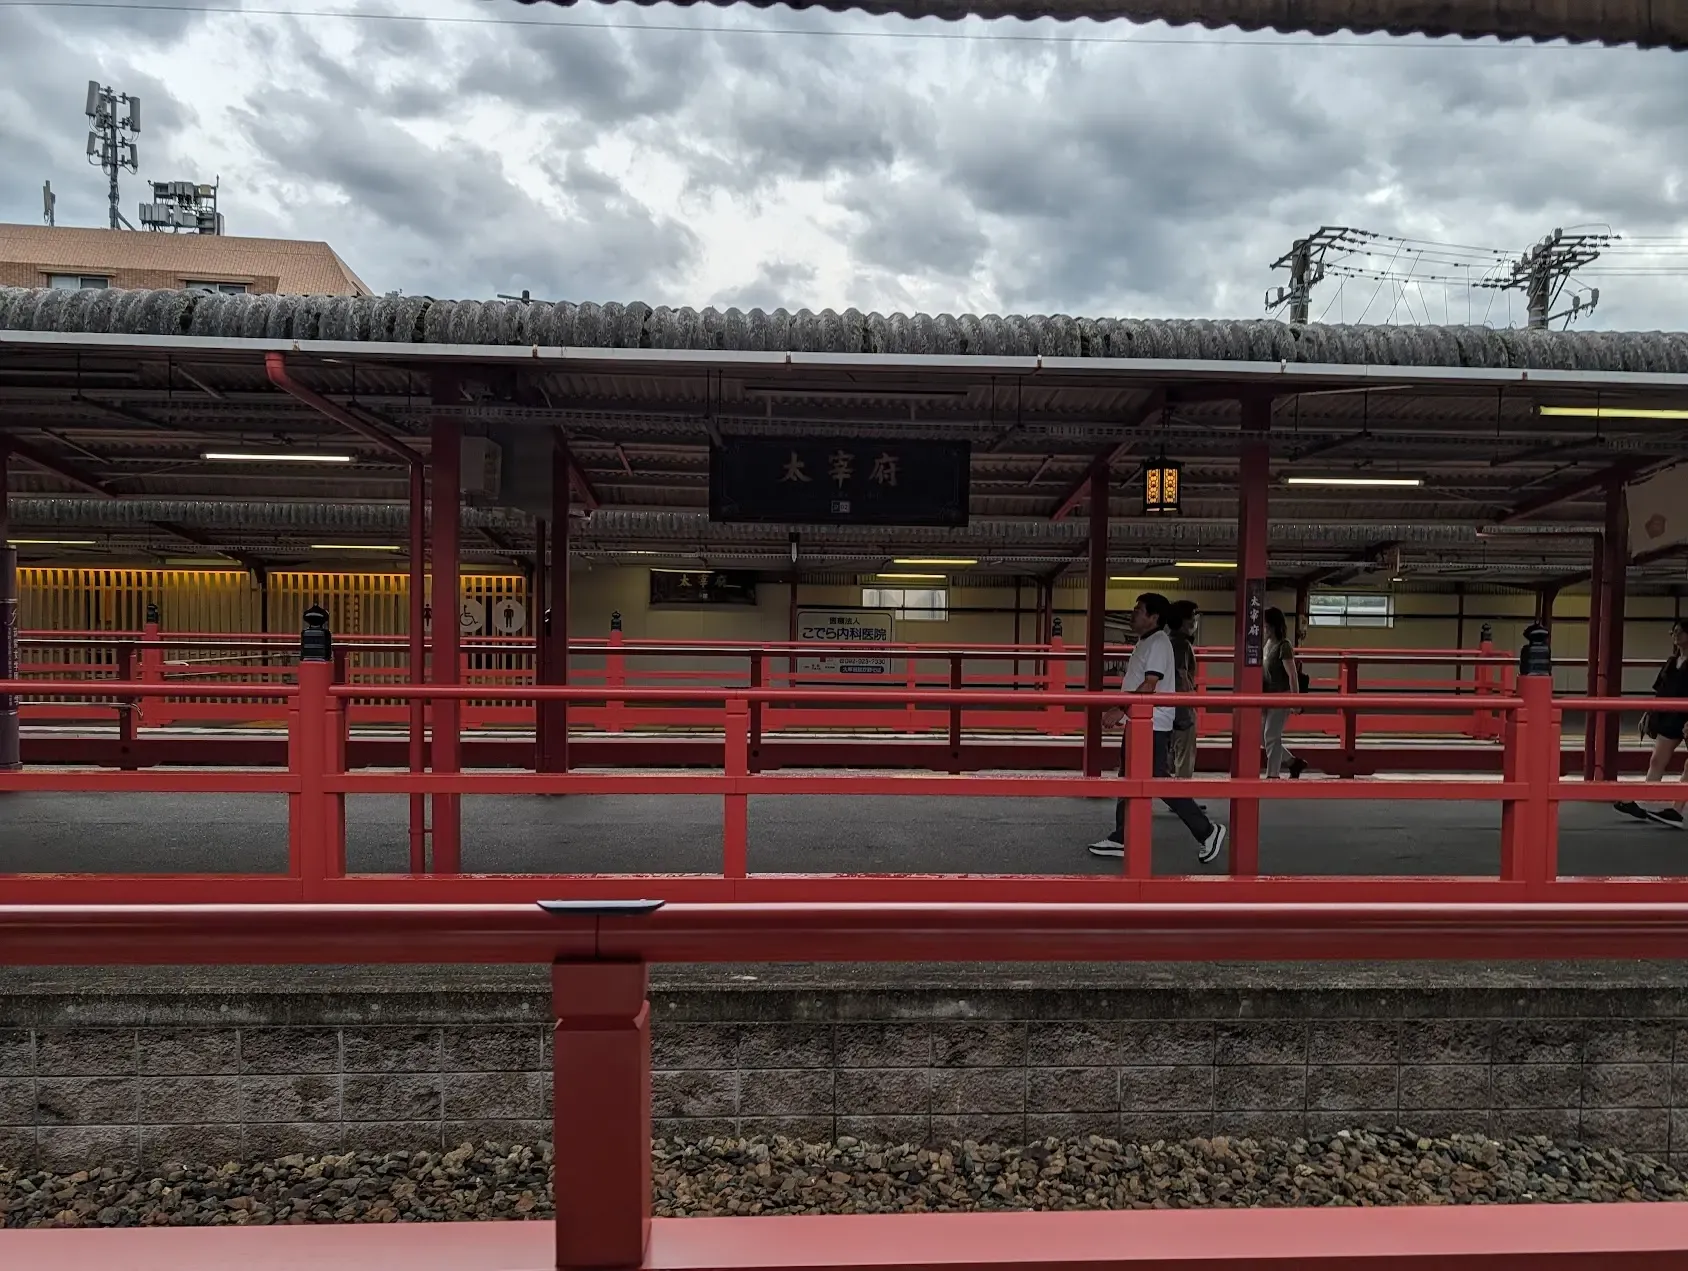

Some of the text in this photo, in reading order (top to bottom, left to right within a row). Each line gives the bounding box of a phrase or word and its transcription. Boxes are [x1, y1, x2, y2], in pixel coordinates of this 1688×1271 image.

[779, 450, 902, 489] 太宰府
[677, 573, 728, 588] 太宰府
[1248, 595, 1261, 636] 太宰府
[802, 627, 887, 641] こでら内科医院
